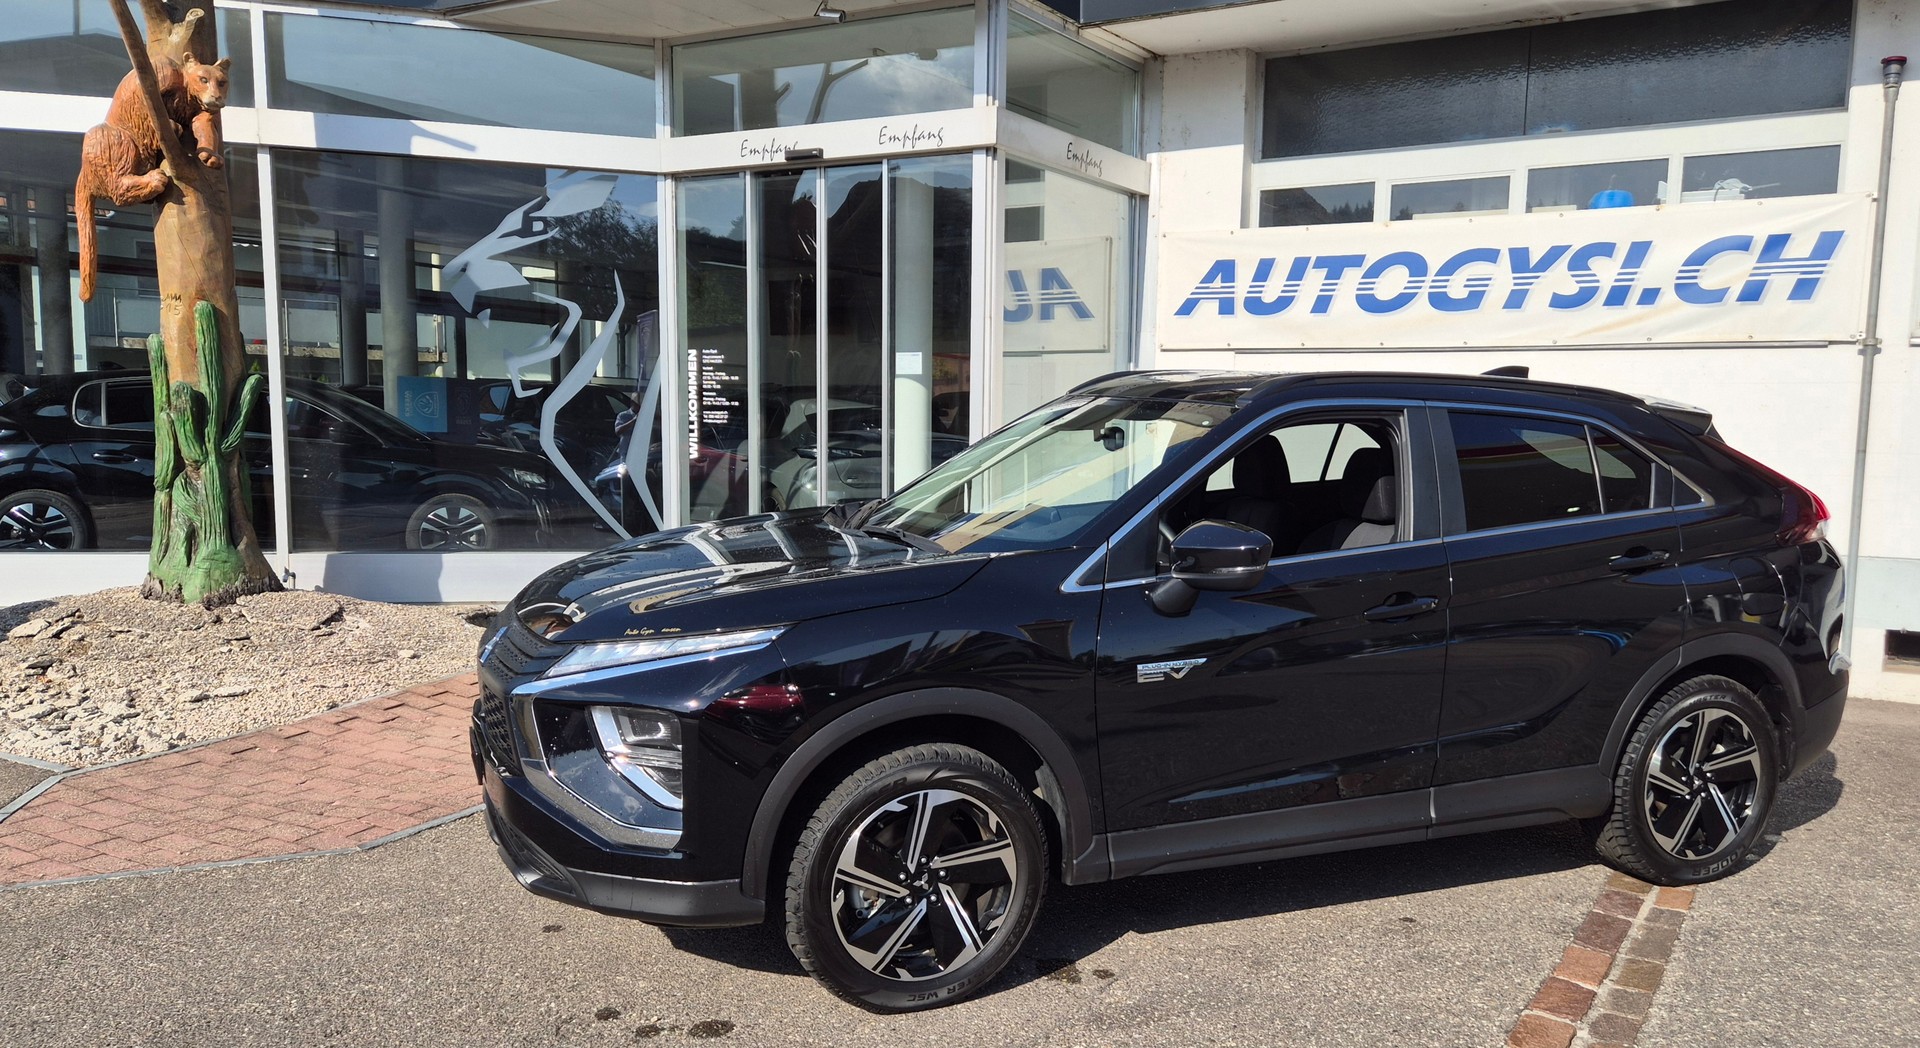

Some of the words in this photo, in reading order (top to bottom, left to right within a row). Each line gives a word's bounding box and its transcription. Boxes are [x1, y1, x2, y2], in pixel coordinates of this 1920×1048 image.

[878, 123, 945, 148] Empfang
[1066, 141, 1103, 178] Empfang
[1173, 230, 1847, 318] AUTOGYSI.CH
[687, 348, 699, 460] WILLKOMMEN
